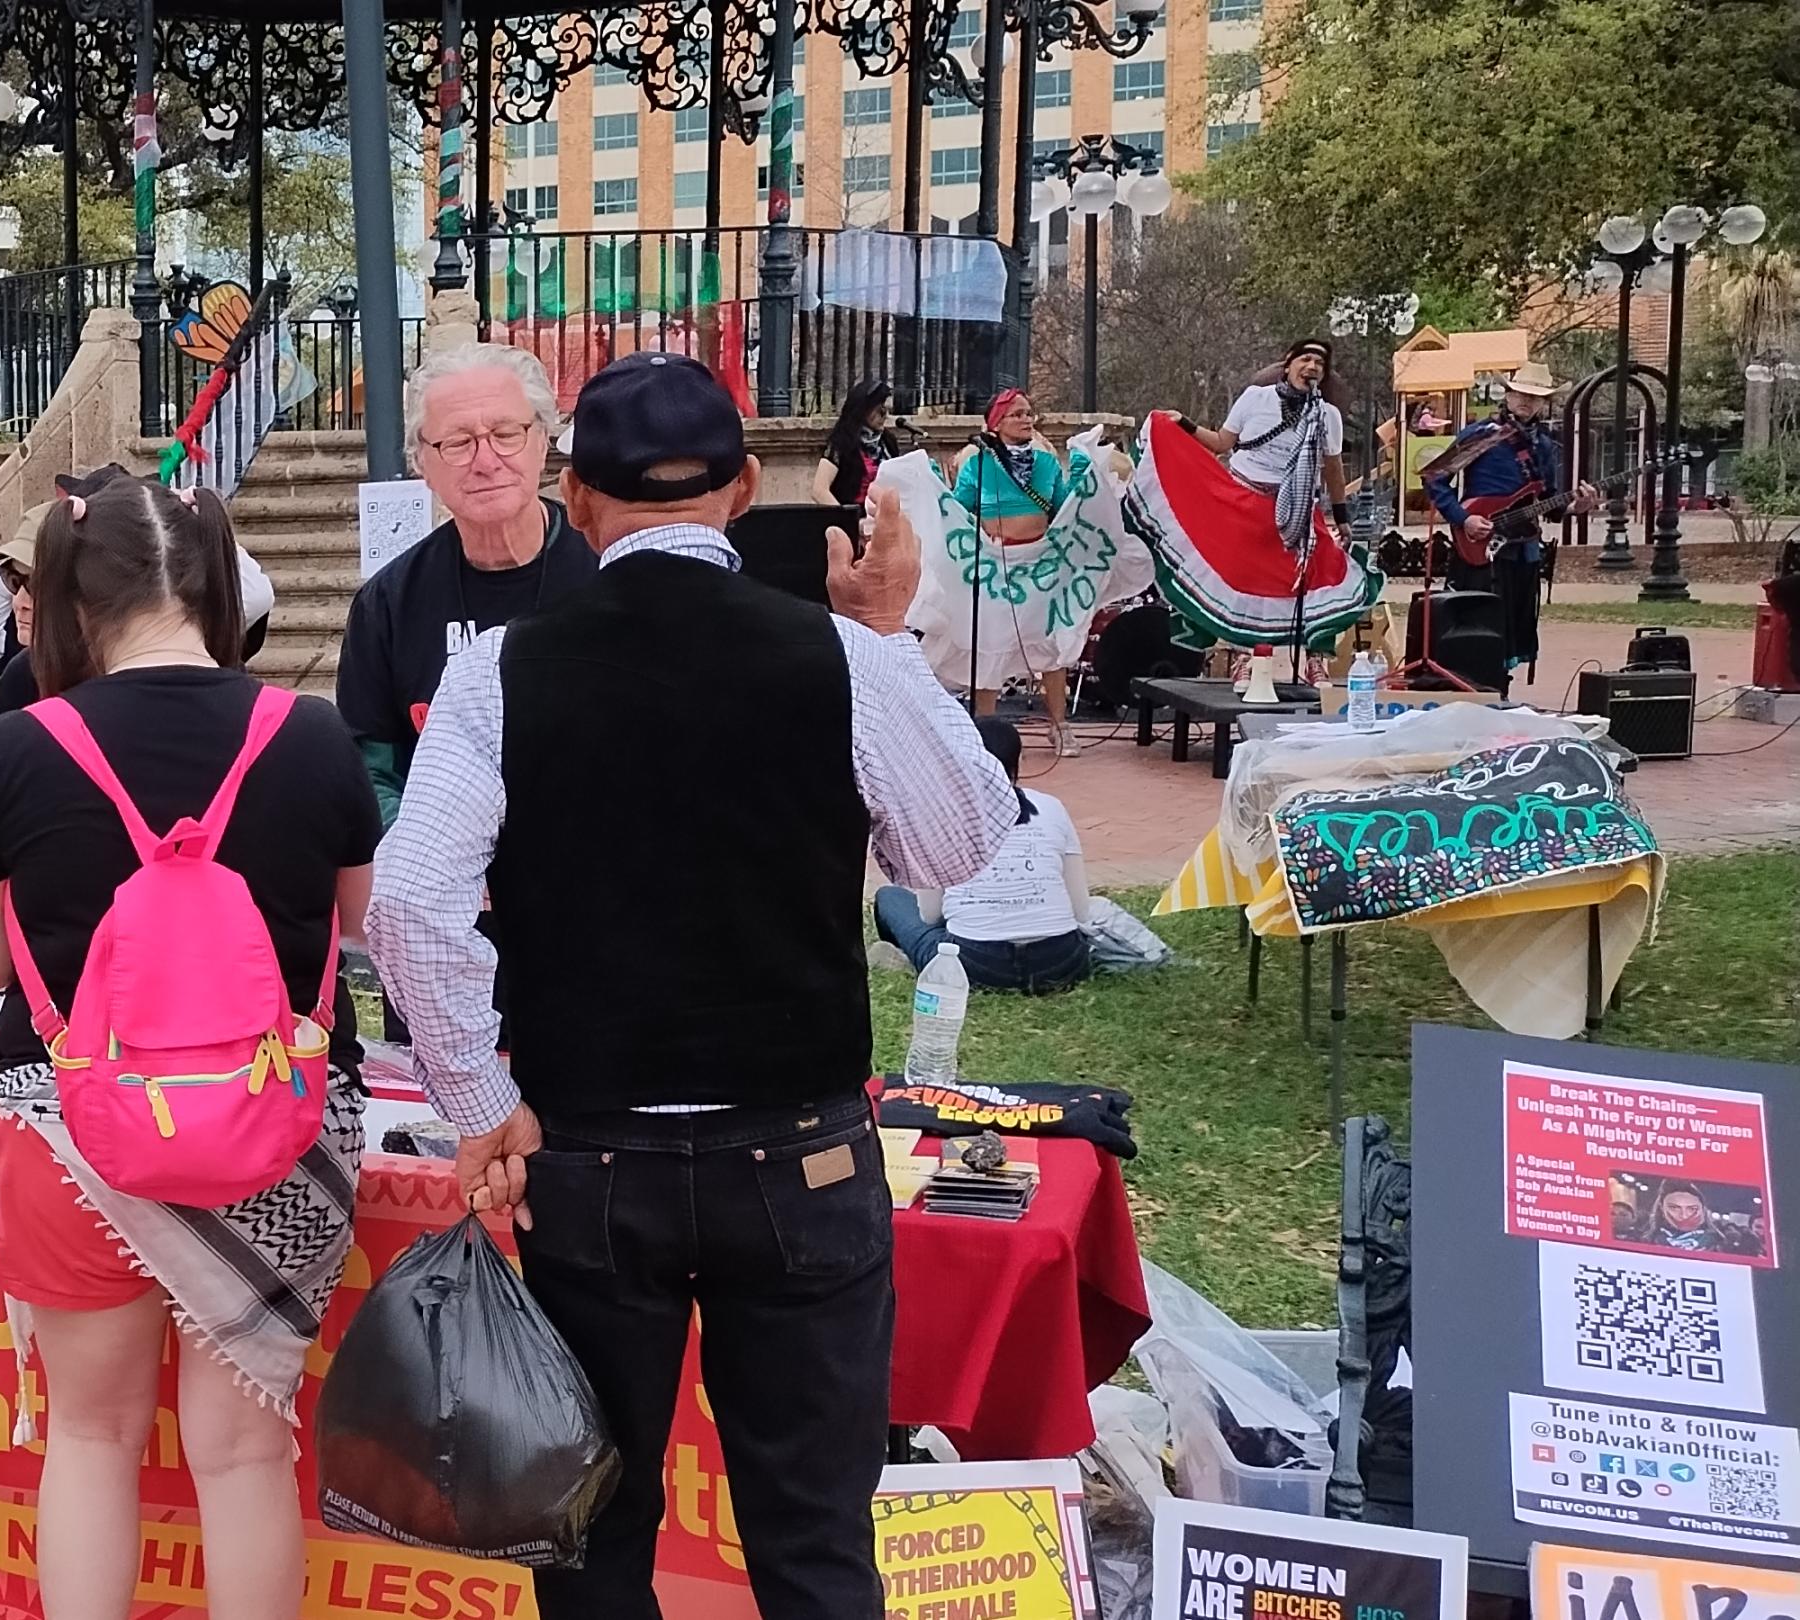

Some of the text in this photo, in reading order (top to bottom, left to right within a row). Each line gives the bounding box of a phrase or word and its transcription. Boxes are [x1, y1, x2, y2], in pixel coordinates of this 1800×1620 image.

[1550, 1083, 1599, 1103] Break
[1603, 1090, 1635, 1107] The
[1517, 1096, 1753, 1139] Unleash The Fury Of Women
[1542, 1117, 1729, 1154] As A Mighty Force For
[1515, 1153, 1575, 1171] A Special
[1586, 1141, 1684, 1167] Revolution!
[1515, 1166, 1606, 1188] Message from
[1515, 1178, 1595, 1199] Bob Avakian
[1515, 1191, 1538, 1204] For
[1516, 1203, 1600, 1225] International
[1516, 1216, 1601, 1240] Women's Day
[1548, 1401, 1757, 1443] Tune into & follow
[1530, 1421, 1780, 1467] @BobAvakianOfficial:
[351, 1503, 381, 1529] RETURN
[381, 1518, 391, 1534] TO
[487, 1548, 505, 1558] FOR
[506, 1539, 553, 1556] RECYCLING
[1540, 1498, 1790, 1540] REVCOM.US @TheRevcoms
[884, 1523, 985, 1564] FORCED
[327, 1559, 523, 1620] LESS!
[882, 1551, 1037, 1599] OTHERHOOD
[1186, 1547, 1347, 1597] WOMEN
[918, 1590, 1016, 1620] FEMALE
[1184, 1579, 1245, 1620] ARE
[1253, 1589, 1341, 1620] BITCHES
